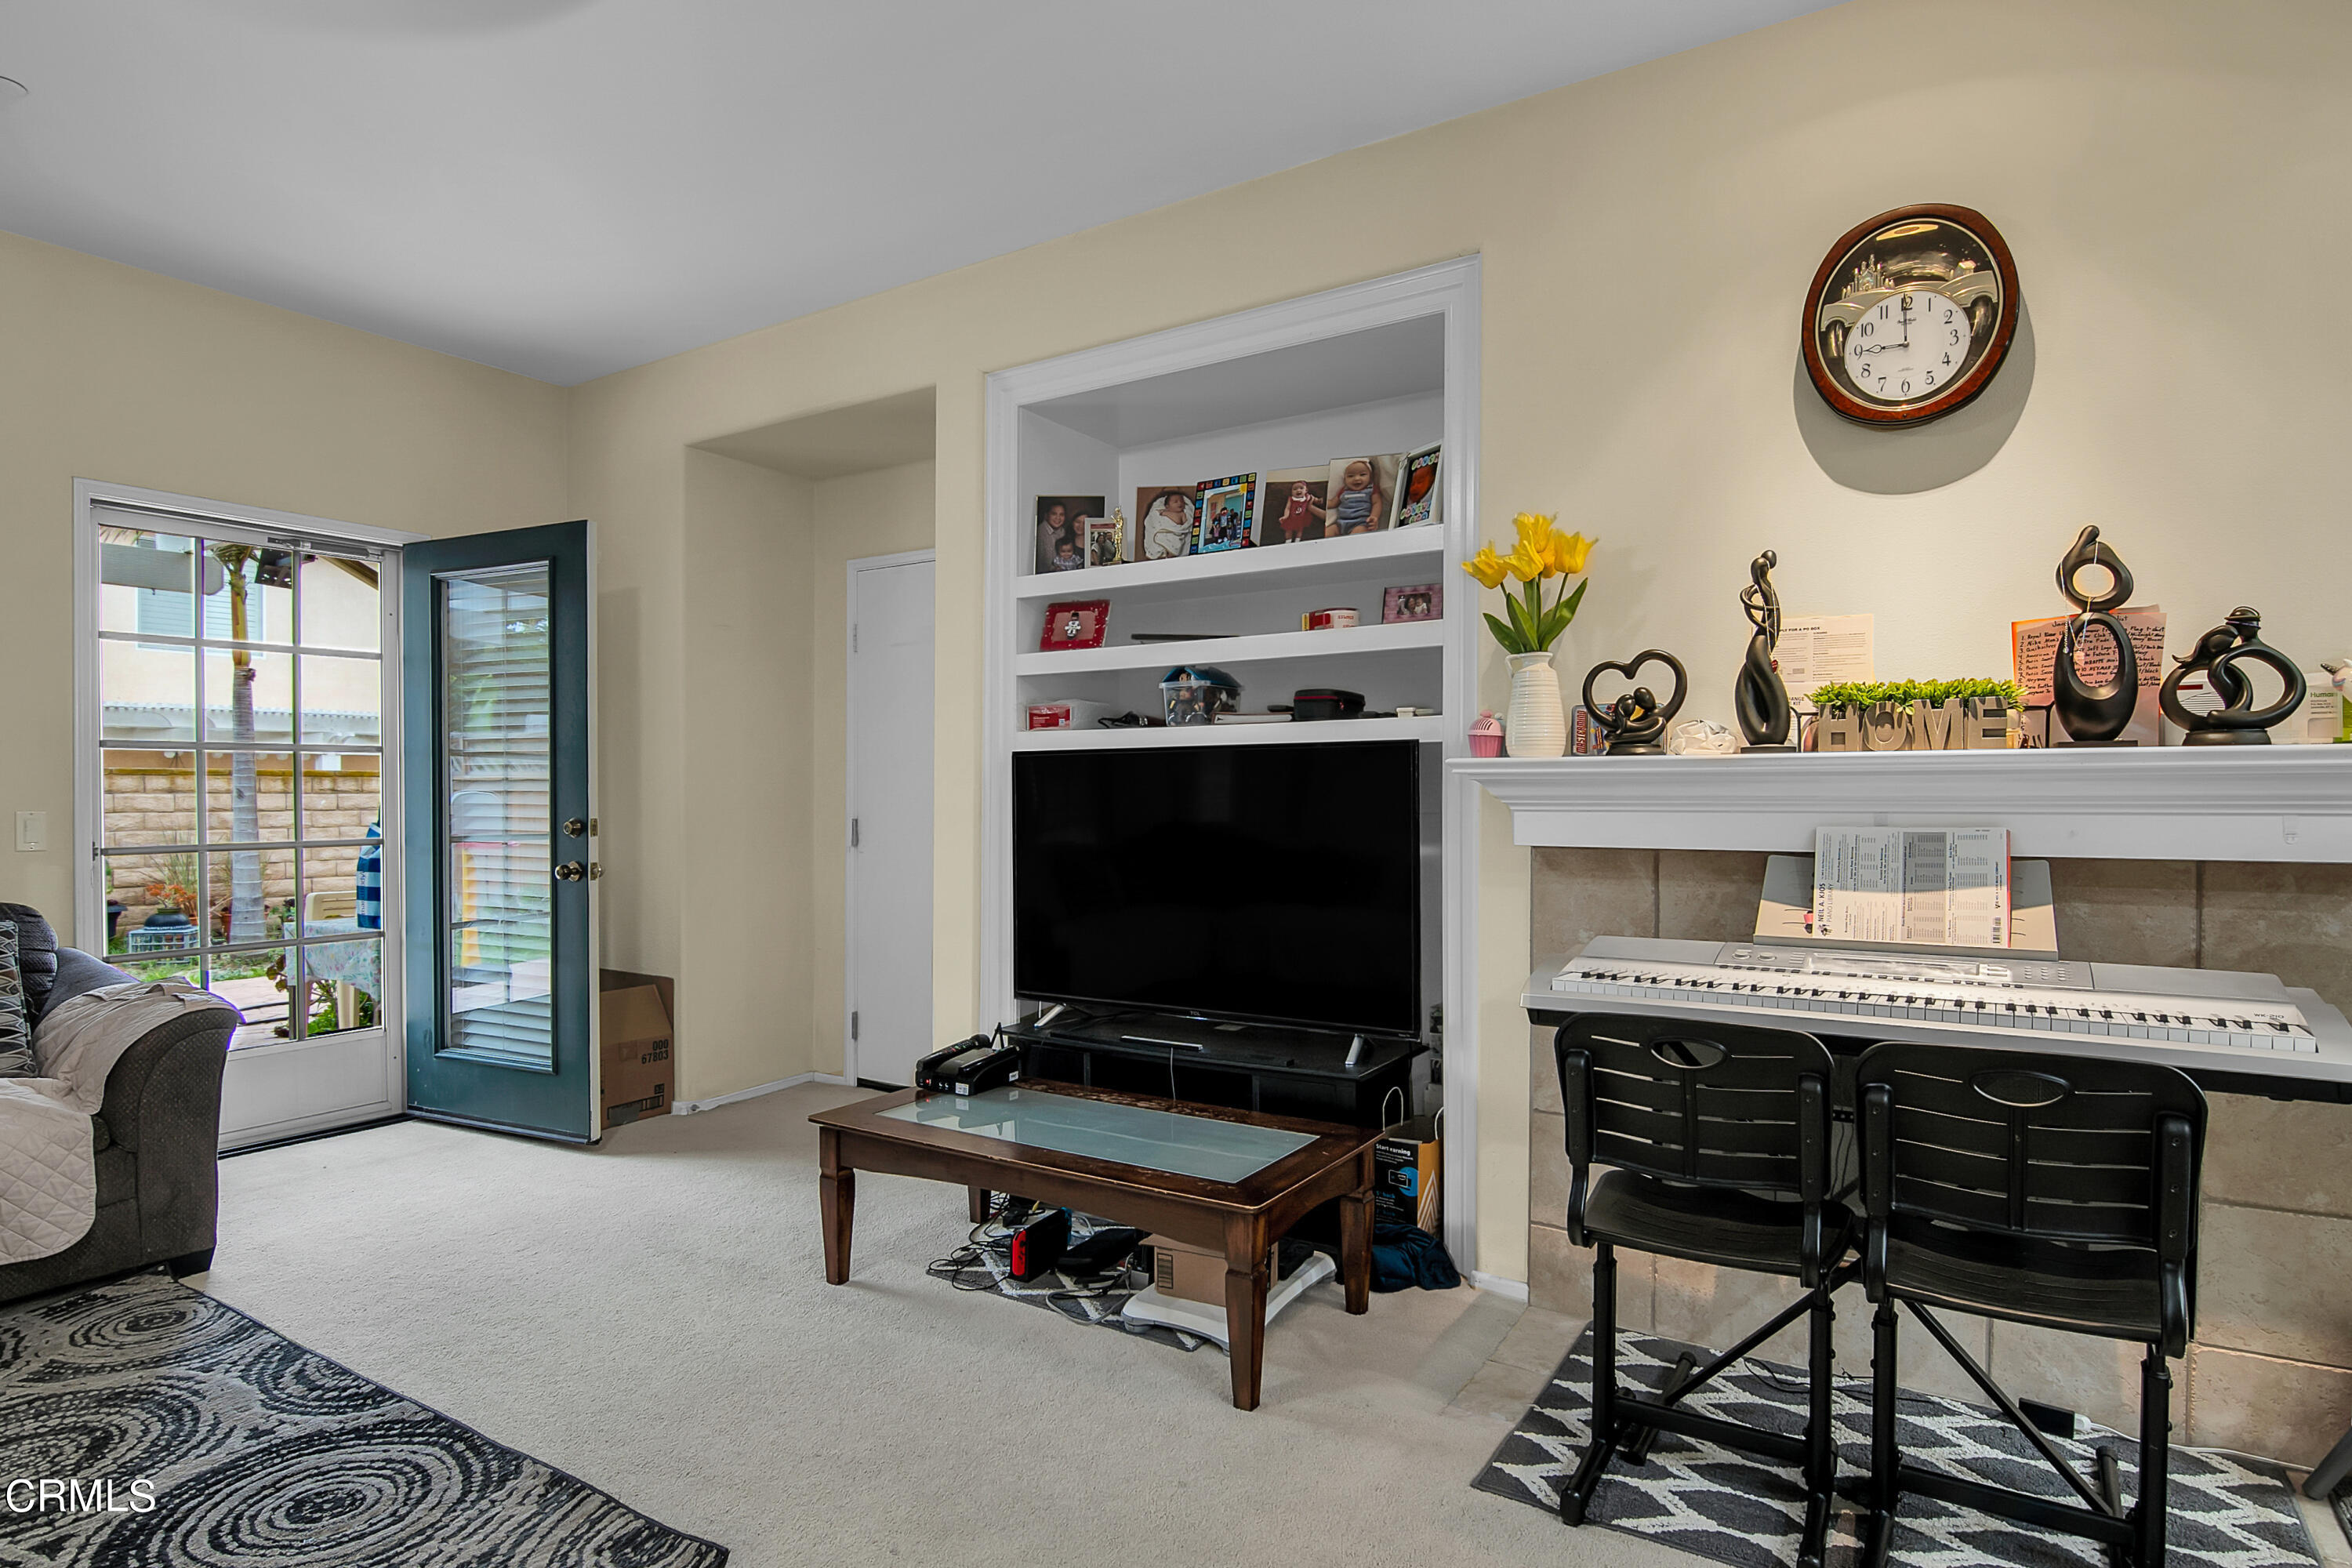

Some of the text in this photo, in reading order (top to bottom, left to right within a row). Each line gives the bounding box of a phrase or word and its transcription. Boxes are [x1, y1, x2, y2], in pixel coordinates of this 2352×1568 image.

[1944, 310, 1953, 324] 2
[1861, 322, 1874, 337] 10
[1949, 329, 1959, 346] 3
[1854, 344, 1863, 360] 9
[1942, 352, 1951, 366] 4
[1861, 364, 1871, 378] 8
[1926, 371, 1934, 385] 5
[1878, 377, 1886, 392] 7
[1901, 378, 1911, 393] 6
[1818, 696, 2008, 751] HOME
[1576, 710, 1588, 753] MASTERMIND
[652, 1039, 669, 1051] 000
[641, 1050, 669, 1064] 67803
